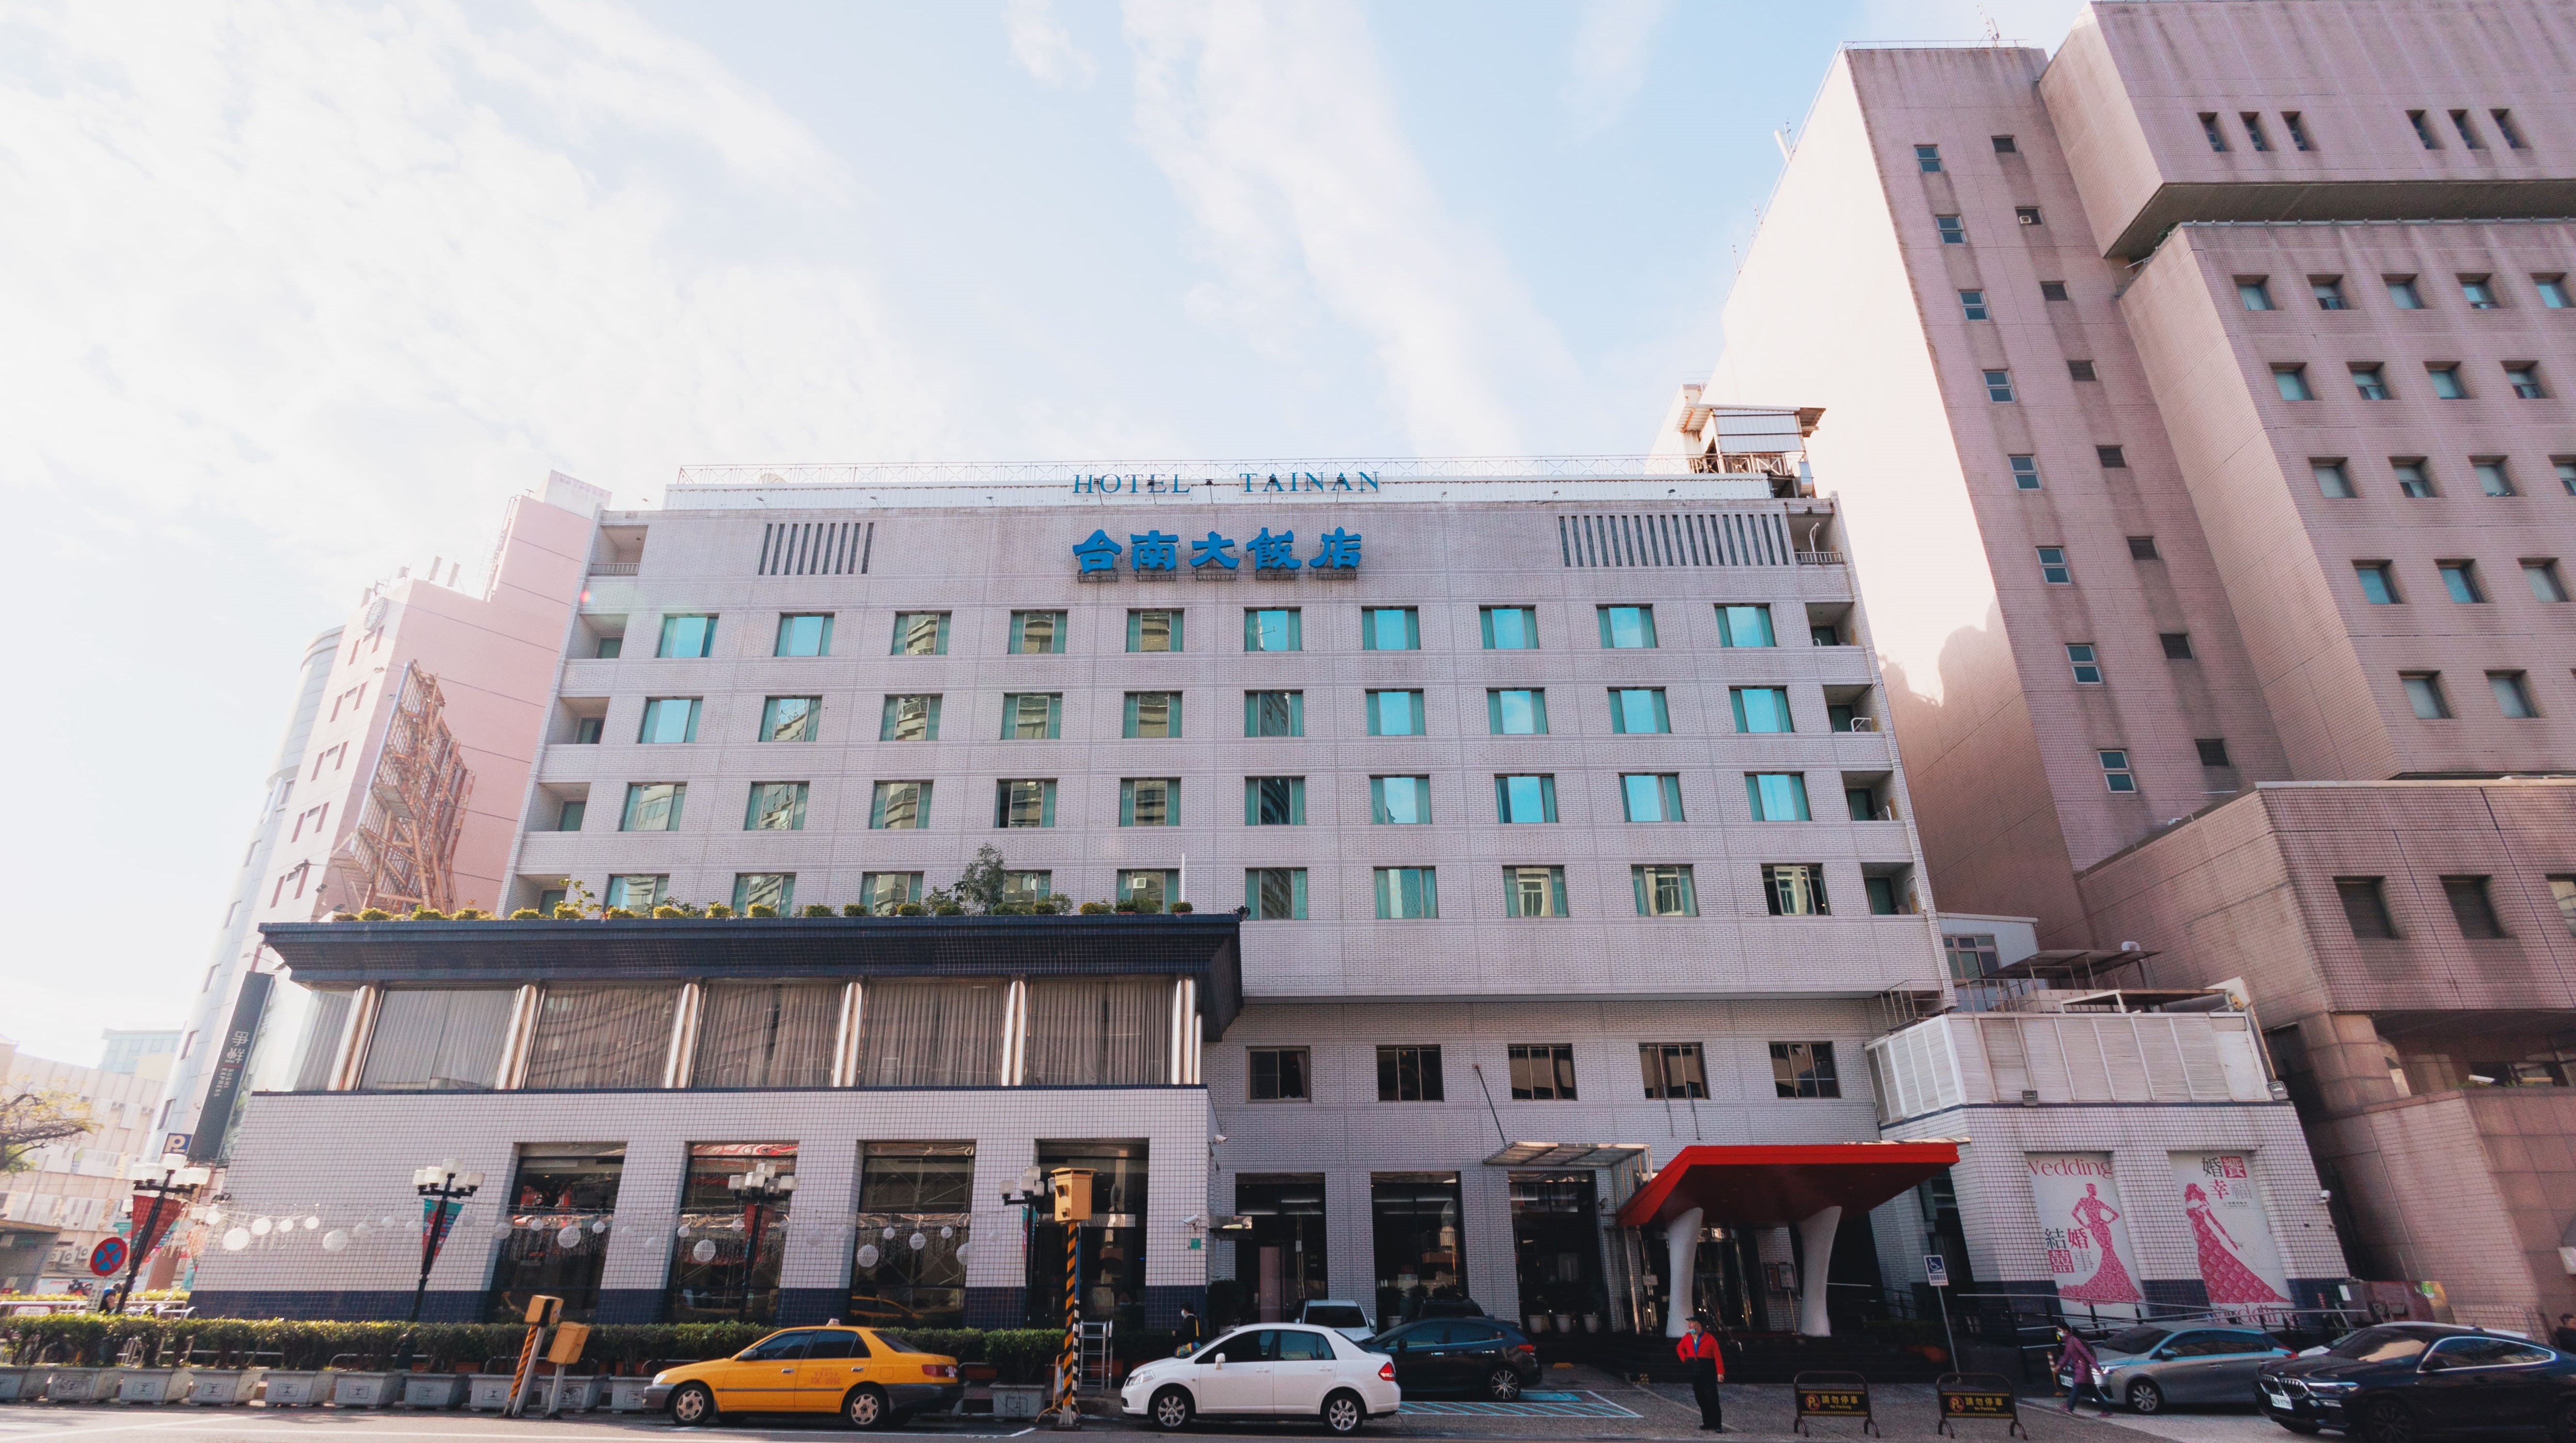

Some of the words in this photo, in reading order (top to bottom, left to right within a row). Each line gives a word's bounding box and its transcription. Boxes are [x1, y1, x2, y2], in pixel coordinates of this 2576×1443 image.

[1072, 474, 1190, 494] HOTEL
[1240, 471, 1380, 493] TAINAN
[1072, 527, 1361, 573] 台南大飯店
[214, 1068, 228, 1097] EXPRESS
[223, 1068, 234, 1088] SUSHI
[2208, 1179, 2253, 1200] 幸福
[2044, 1228, 2089, 1249] 結婚
[1822, 1395, 1858, 1404] 請勿停車
[1965, 1397, 2003, 1406] 請勿停車
